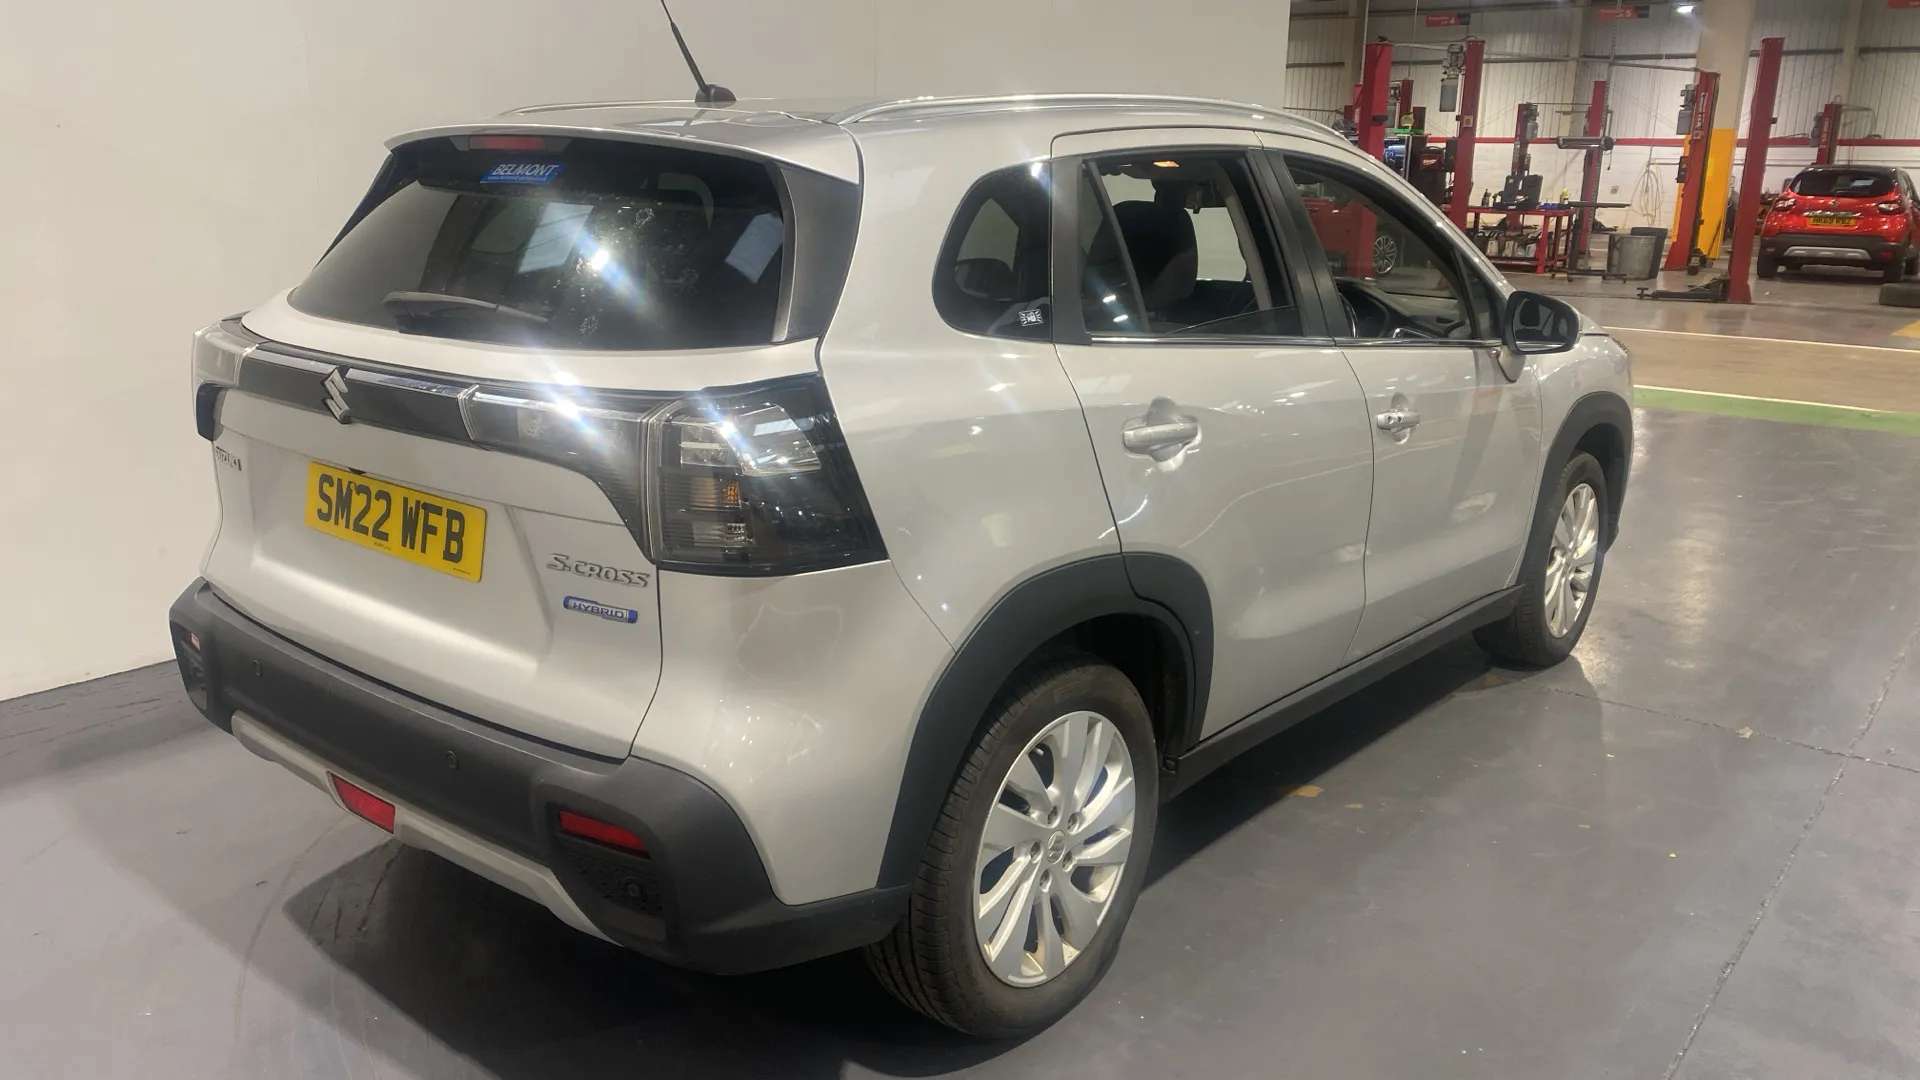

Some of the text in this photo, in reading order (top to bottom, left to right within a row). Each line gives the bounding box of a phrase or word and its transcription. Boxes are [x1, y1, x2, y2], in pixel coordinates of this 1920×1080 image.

[492, 163, 559, 176] BELMONT
[316, 473, 465, 564] SM22 WFB
[572, 601, 625, 619] HYBRID
